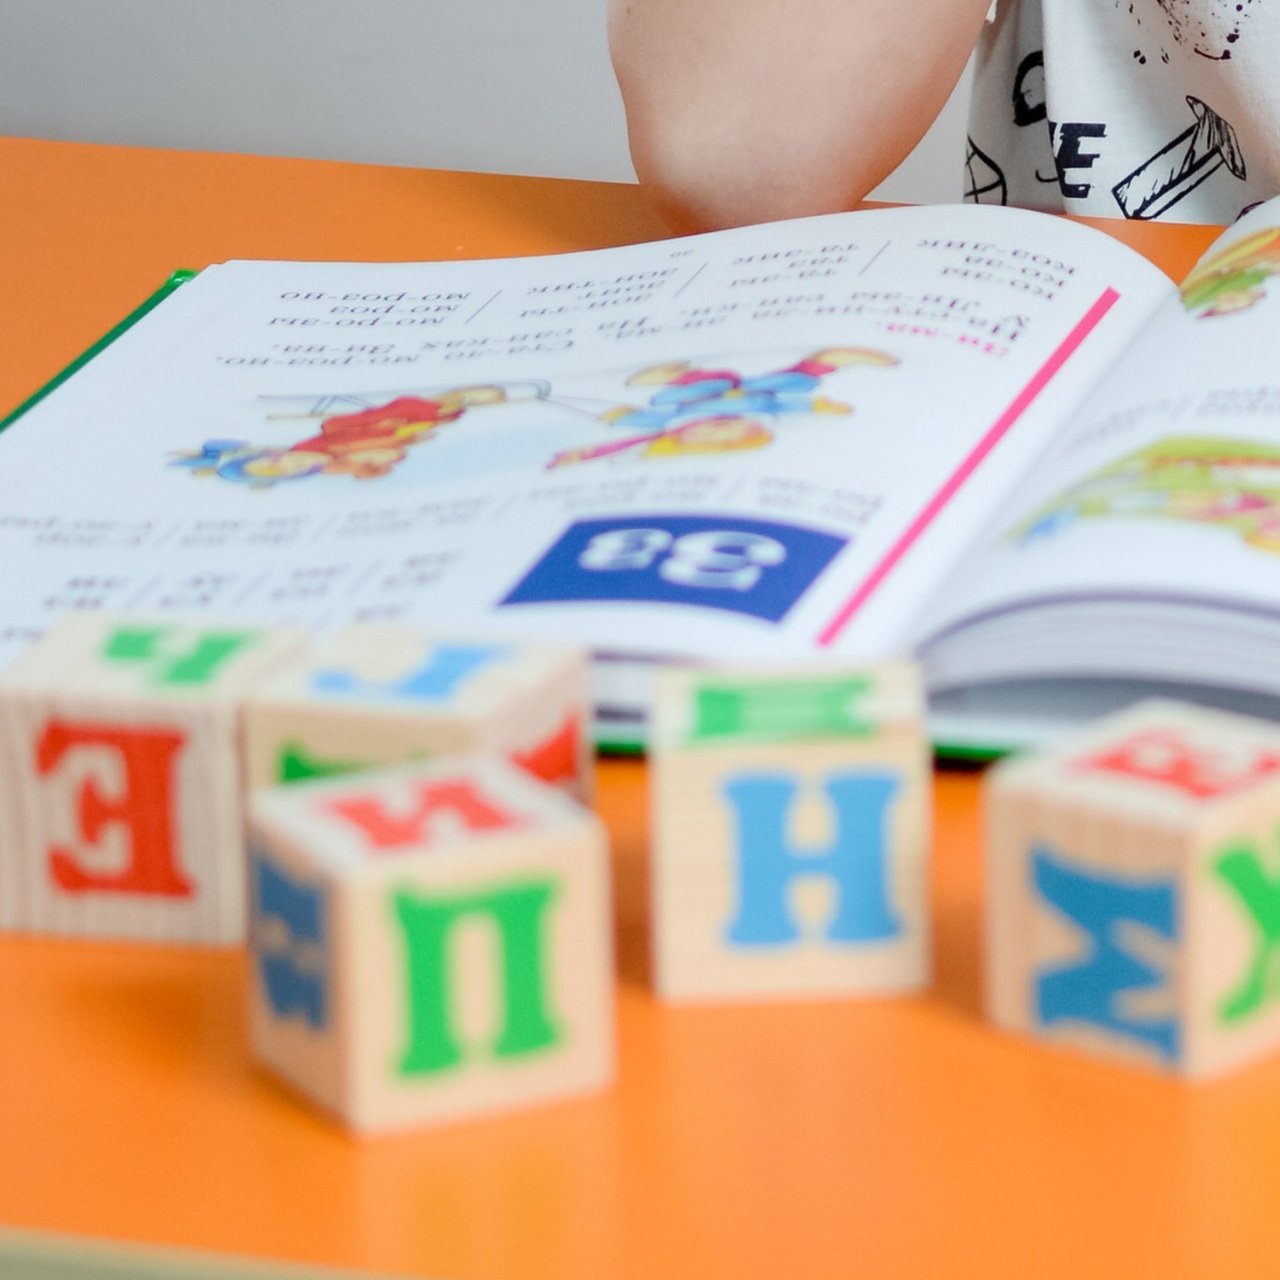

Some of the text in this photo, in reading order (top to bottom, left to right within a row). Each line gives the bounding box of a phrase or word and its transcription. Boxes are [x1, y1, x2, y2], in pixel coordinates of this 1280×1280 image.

[577, 527, 788, 592] Зз
[35, 720, 197, 900] Е
[718, 767, 906, 949] Н
[390, 876, 563, 1080] П
